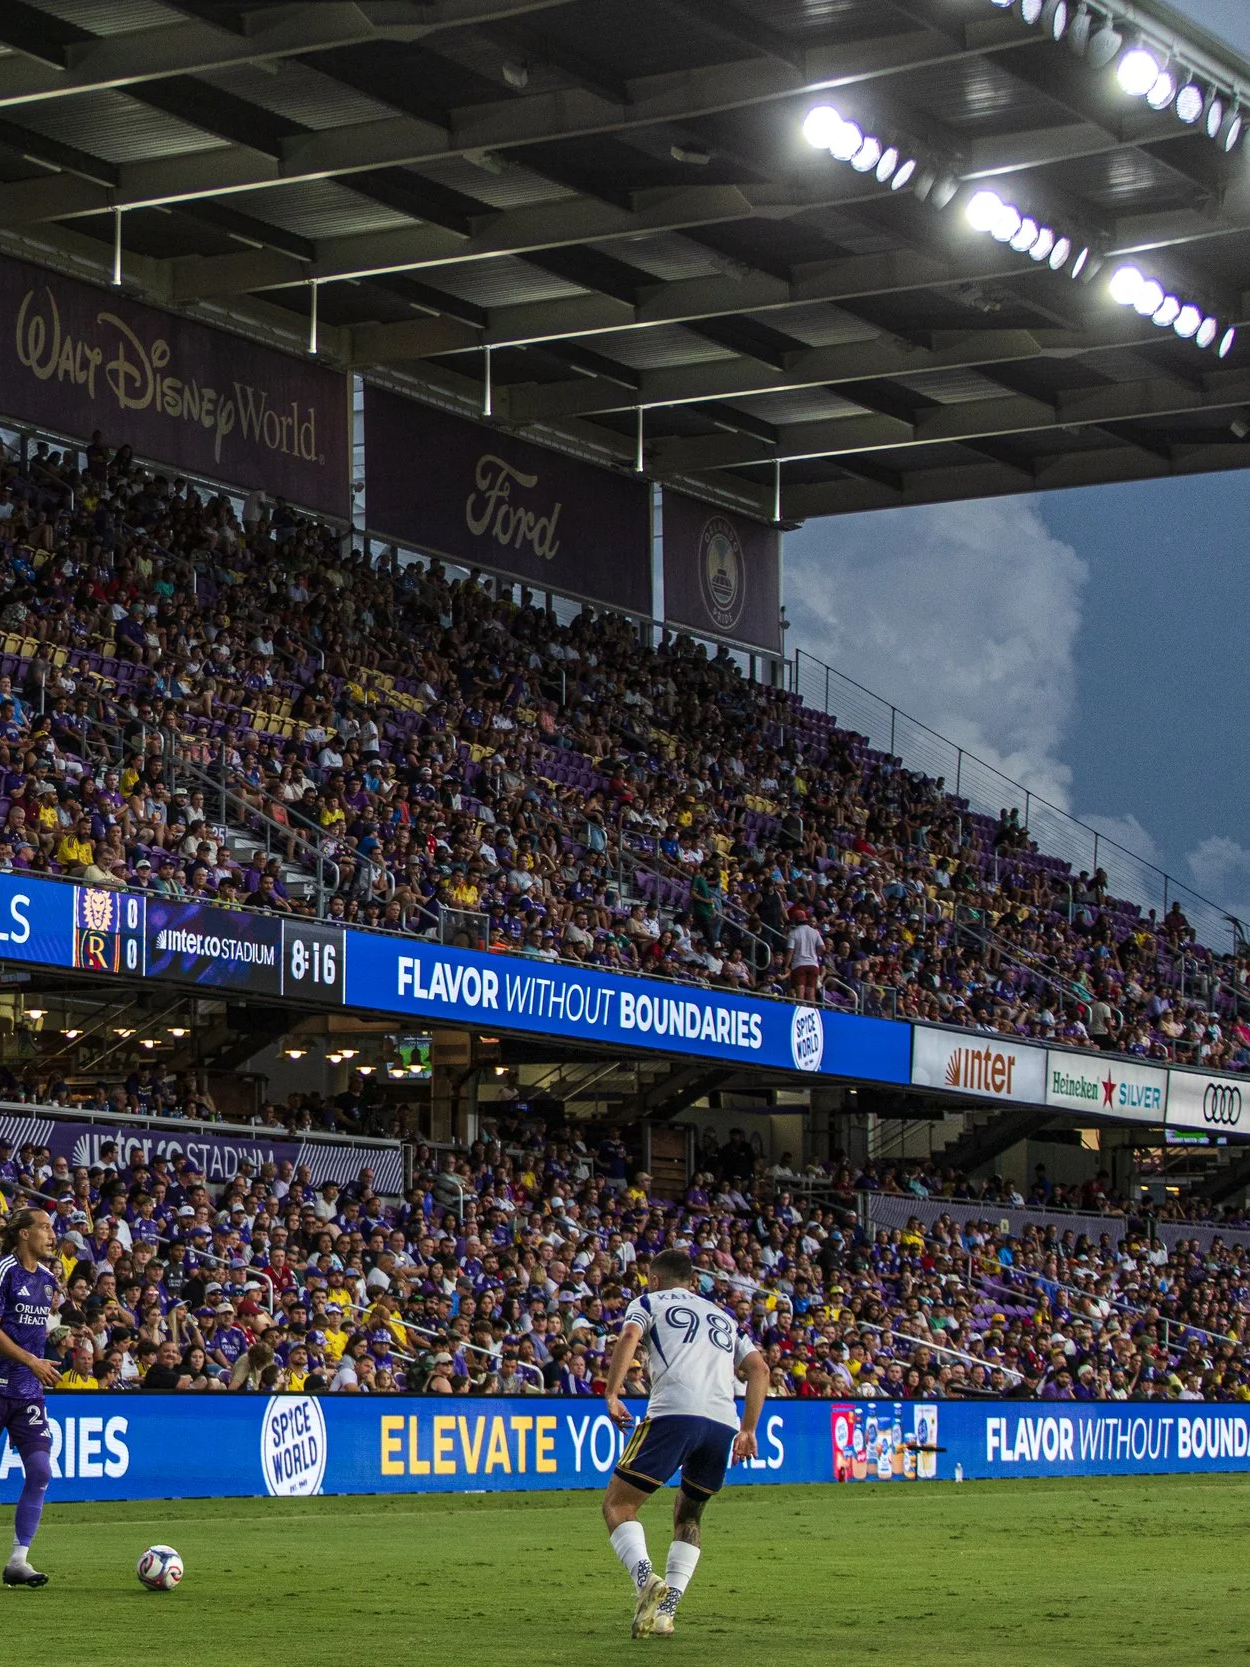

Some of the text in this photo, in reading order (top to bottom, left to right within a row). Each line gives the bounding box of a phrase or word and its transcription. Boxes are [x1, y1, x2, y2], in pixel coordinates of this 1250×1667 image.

[465, 454, 562, 560] Ford
[127, 898, 138, 930] 0
[127, 938, 138, 970] 0
[221, 939, 275, 966] STADIUM
[397, 956, 763, 1050] FLAVOR WITHOUT BOUNDARIES
[963, 1044, 1015, 1094] inter
[1052, 1071, 1161, 1110] Heineken SILVER
[19, 1313, 46, 1325] HEALT
[666, 1305, 733, 1354] 98
[271, 1401, 311, 1448] SPICE
[380, 1415, 557, 1476] ELEVATE
[986, 1416, 1074, 1463] FLAVOR
[1079, 1417, 1174, 1461] WITHOUT
[1178, 1416, 1250, 1459] BOUND
[272, 1435, 318, 1485] WORLD
